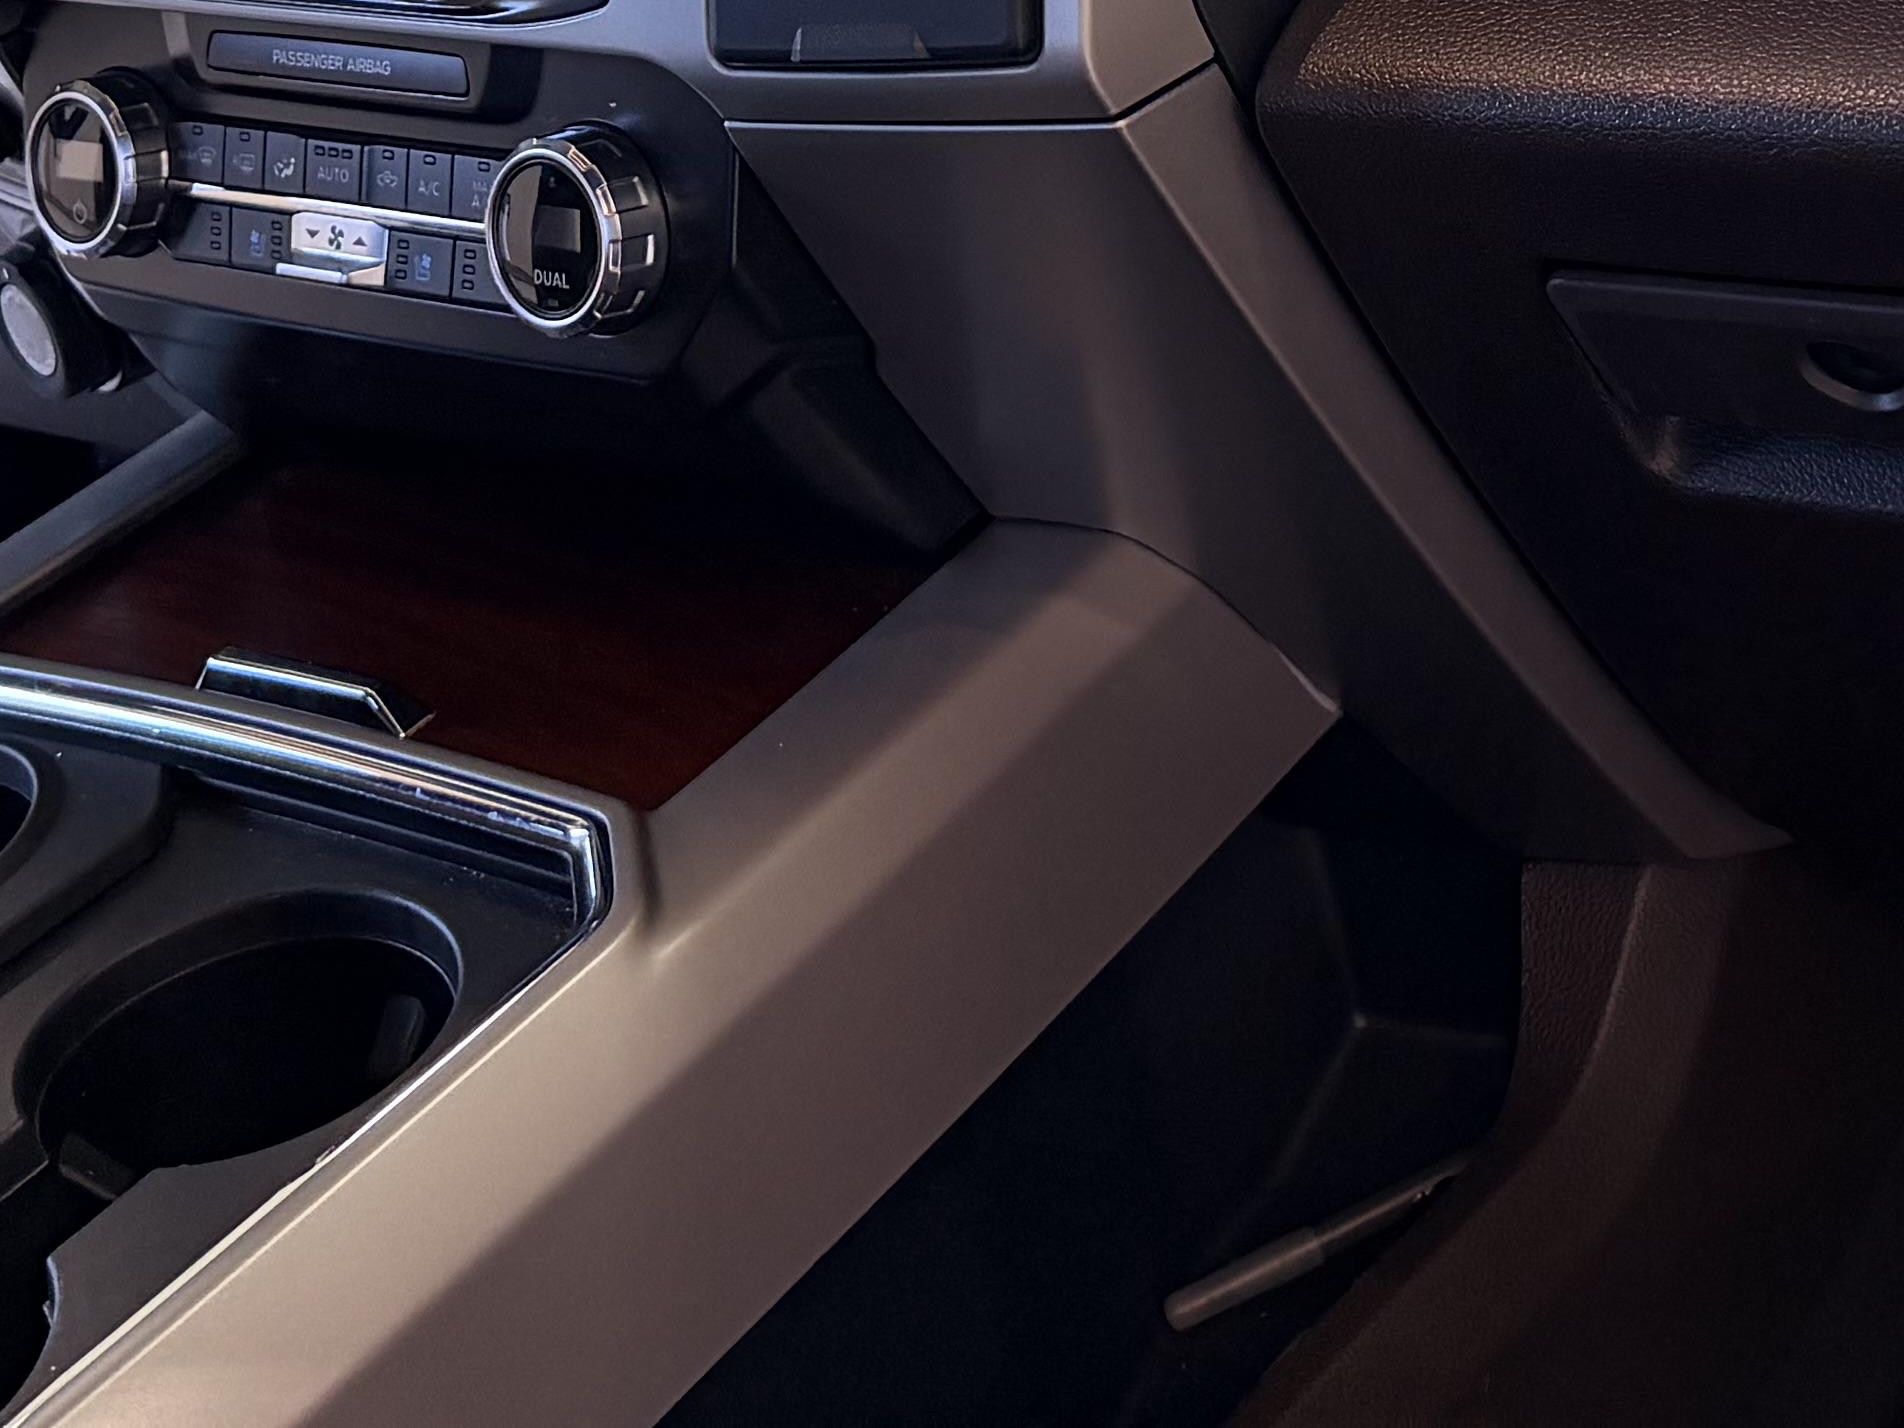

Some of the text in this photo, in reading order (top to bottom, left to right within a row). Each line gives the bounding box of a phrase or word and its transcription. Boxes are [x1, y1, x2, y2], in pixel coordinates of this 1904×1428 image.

[272, 48, 392, 76] PASSENGER AIRBAG
[317, 165, 350, 183] AUTO
[417, 179, 440, 197] A/C
[533, 268, 571, 290] DUAL
